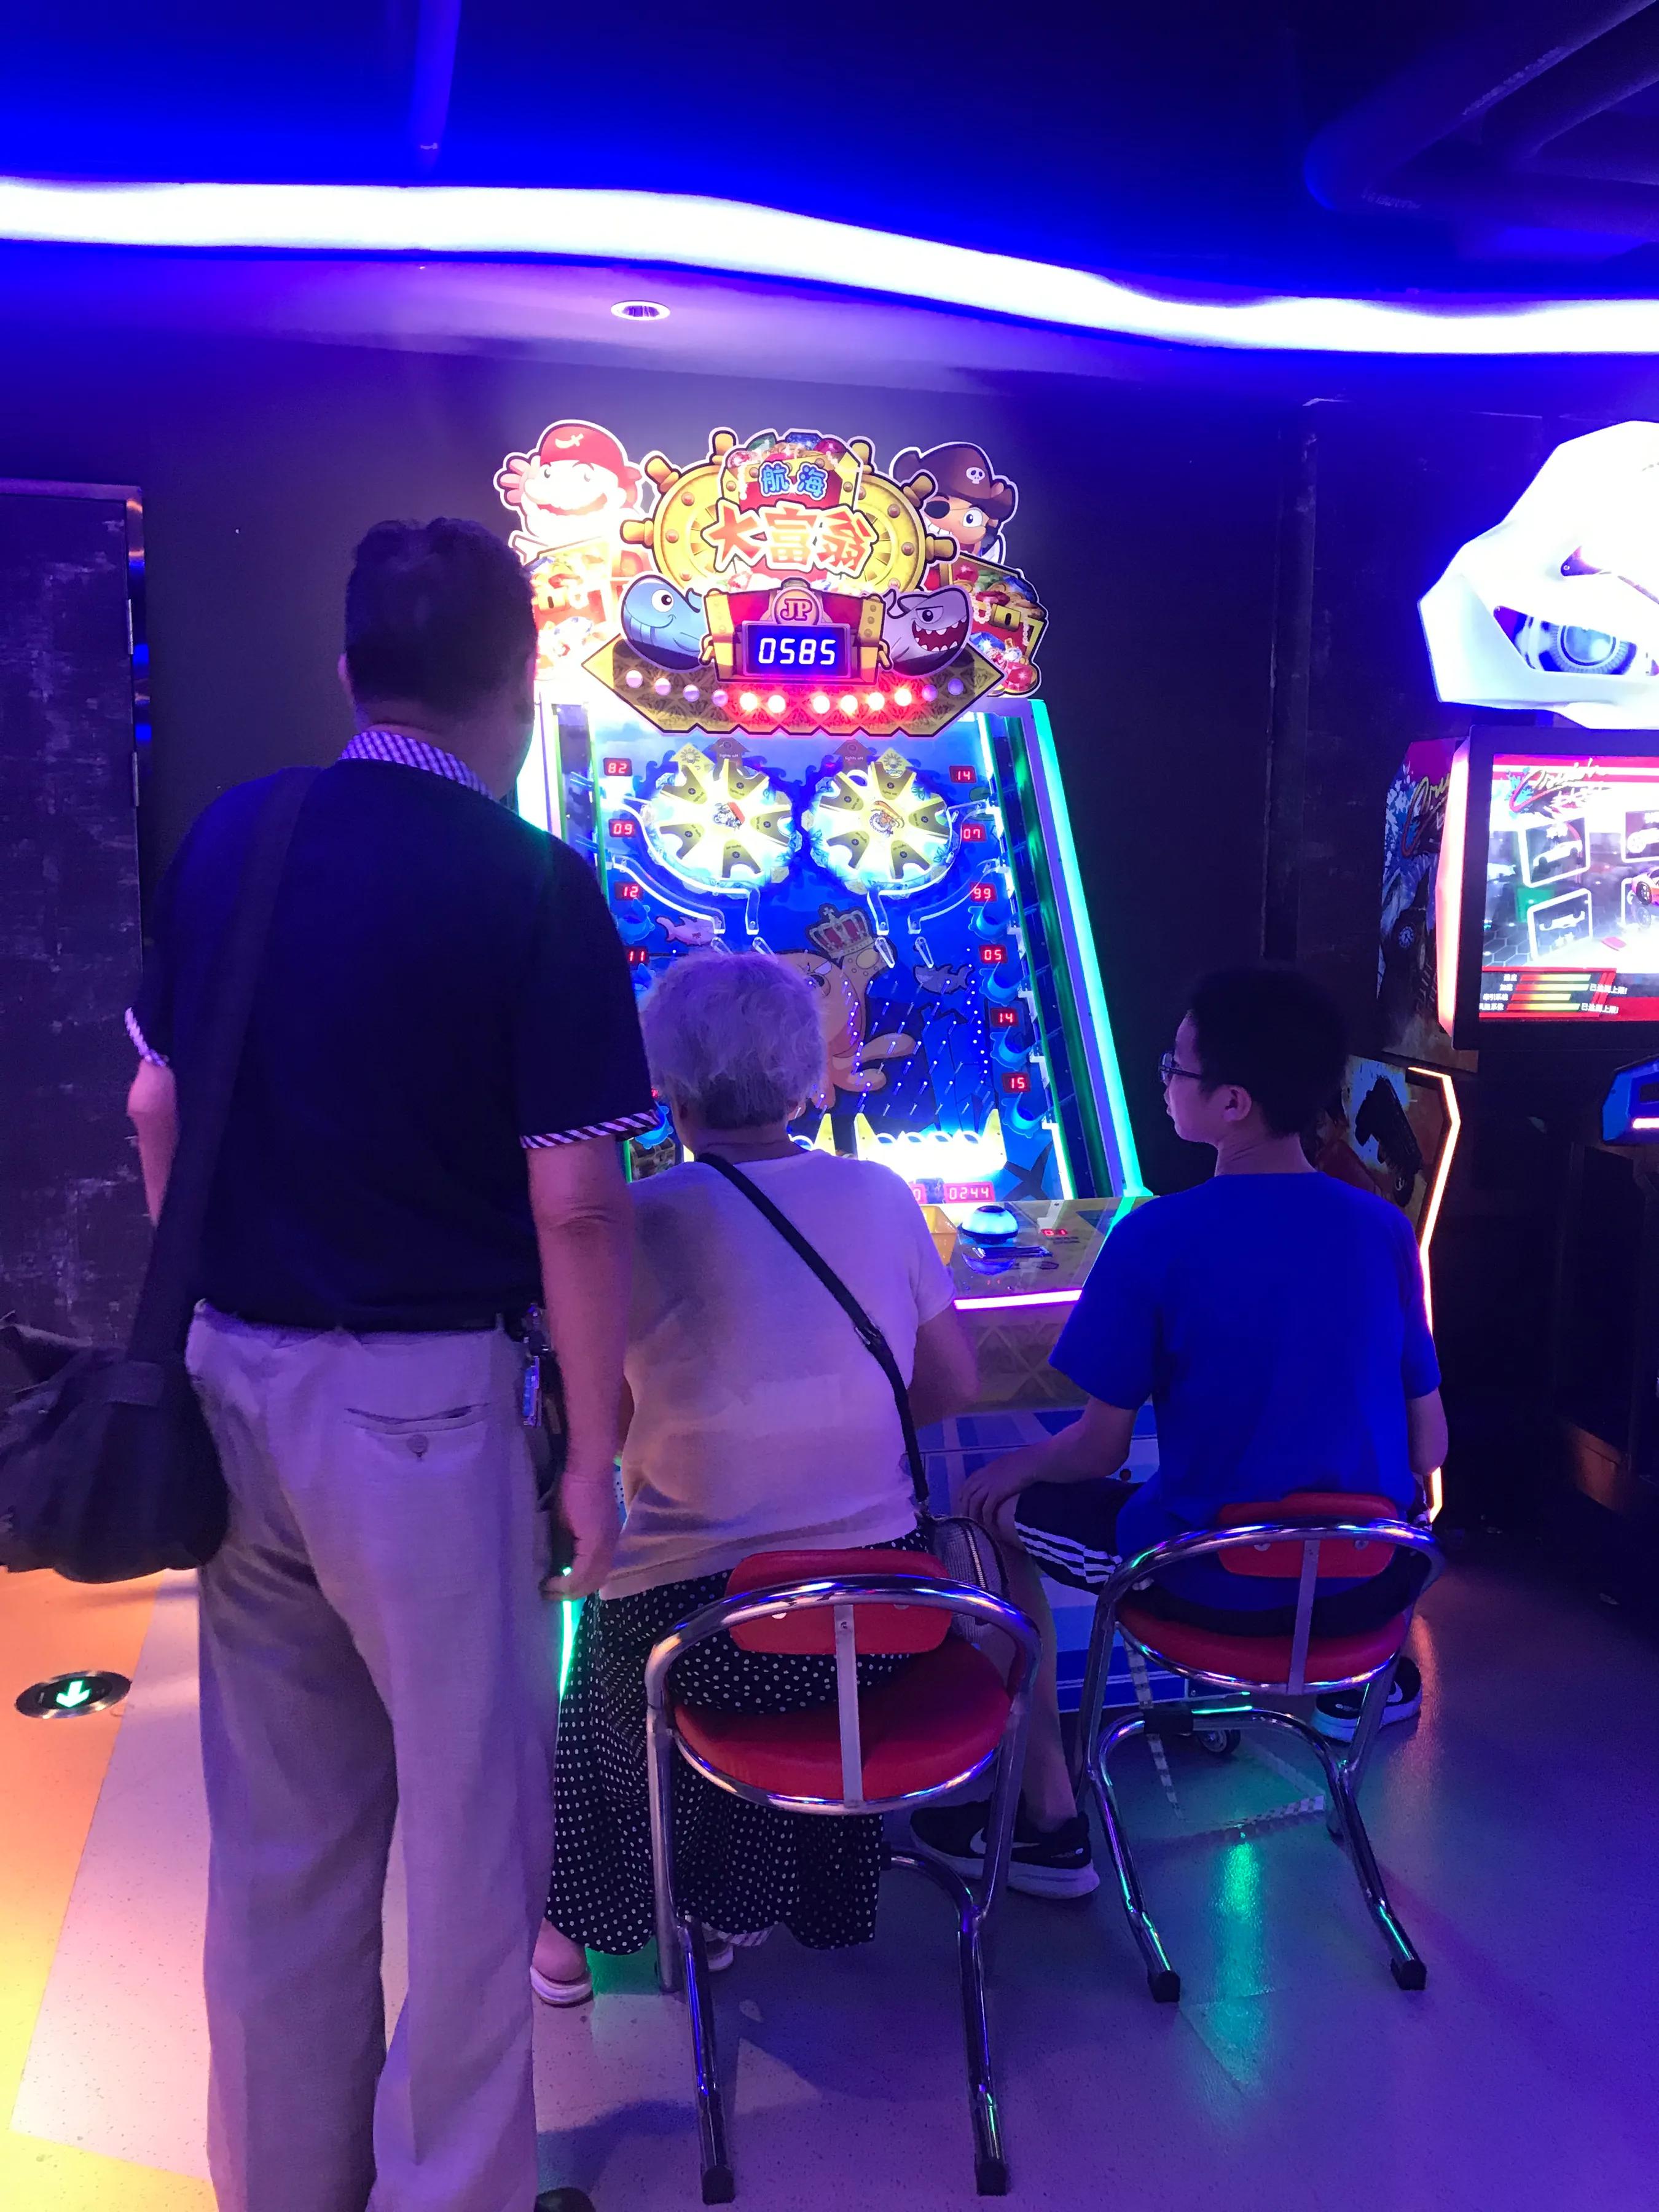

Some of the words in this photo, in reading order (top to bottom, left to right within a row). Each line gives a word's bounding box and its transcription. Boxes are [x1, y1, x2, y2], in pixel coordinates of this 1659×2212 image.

[759, 463, 827, 499] 航海
[707, 504, 873, 572] 大富翁
[781, 598, 812, 621] JP
[758, 637, 836, 665] 0585
[607, 763, 627, 774] 82
[957, 770, 971, 780] 14
[614, 823, 633, 836] 09
[963, 828, 981, 839] 07
[623, 886, 638, 898] 12
[973, 887, 992, 901] 99
[629, 950, 645, 962] 11
[983, 949, 1002, 961] 05
[999, 1012, 1014, 1024] 14
[1010, 1077, 1026, 1089] 15
[949, 1186, 989, 1200] 0244
